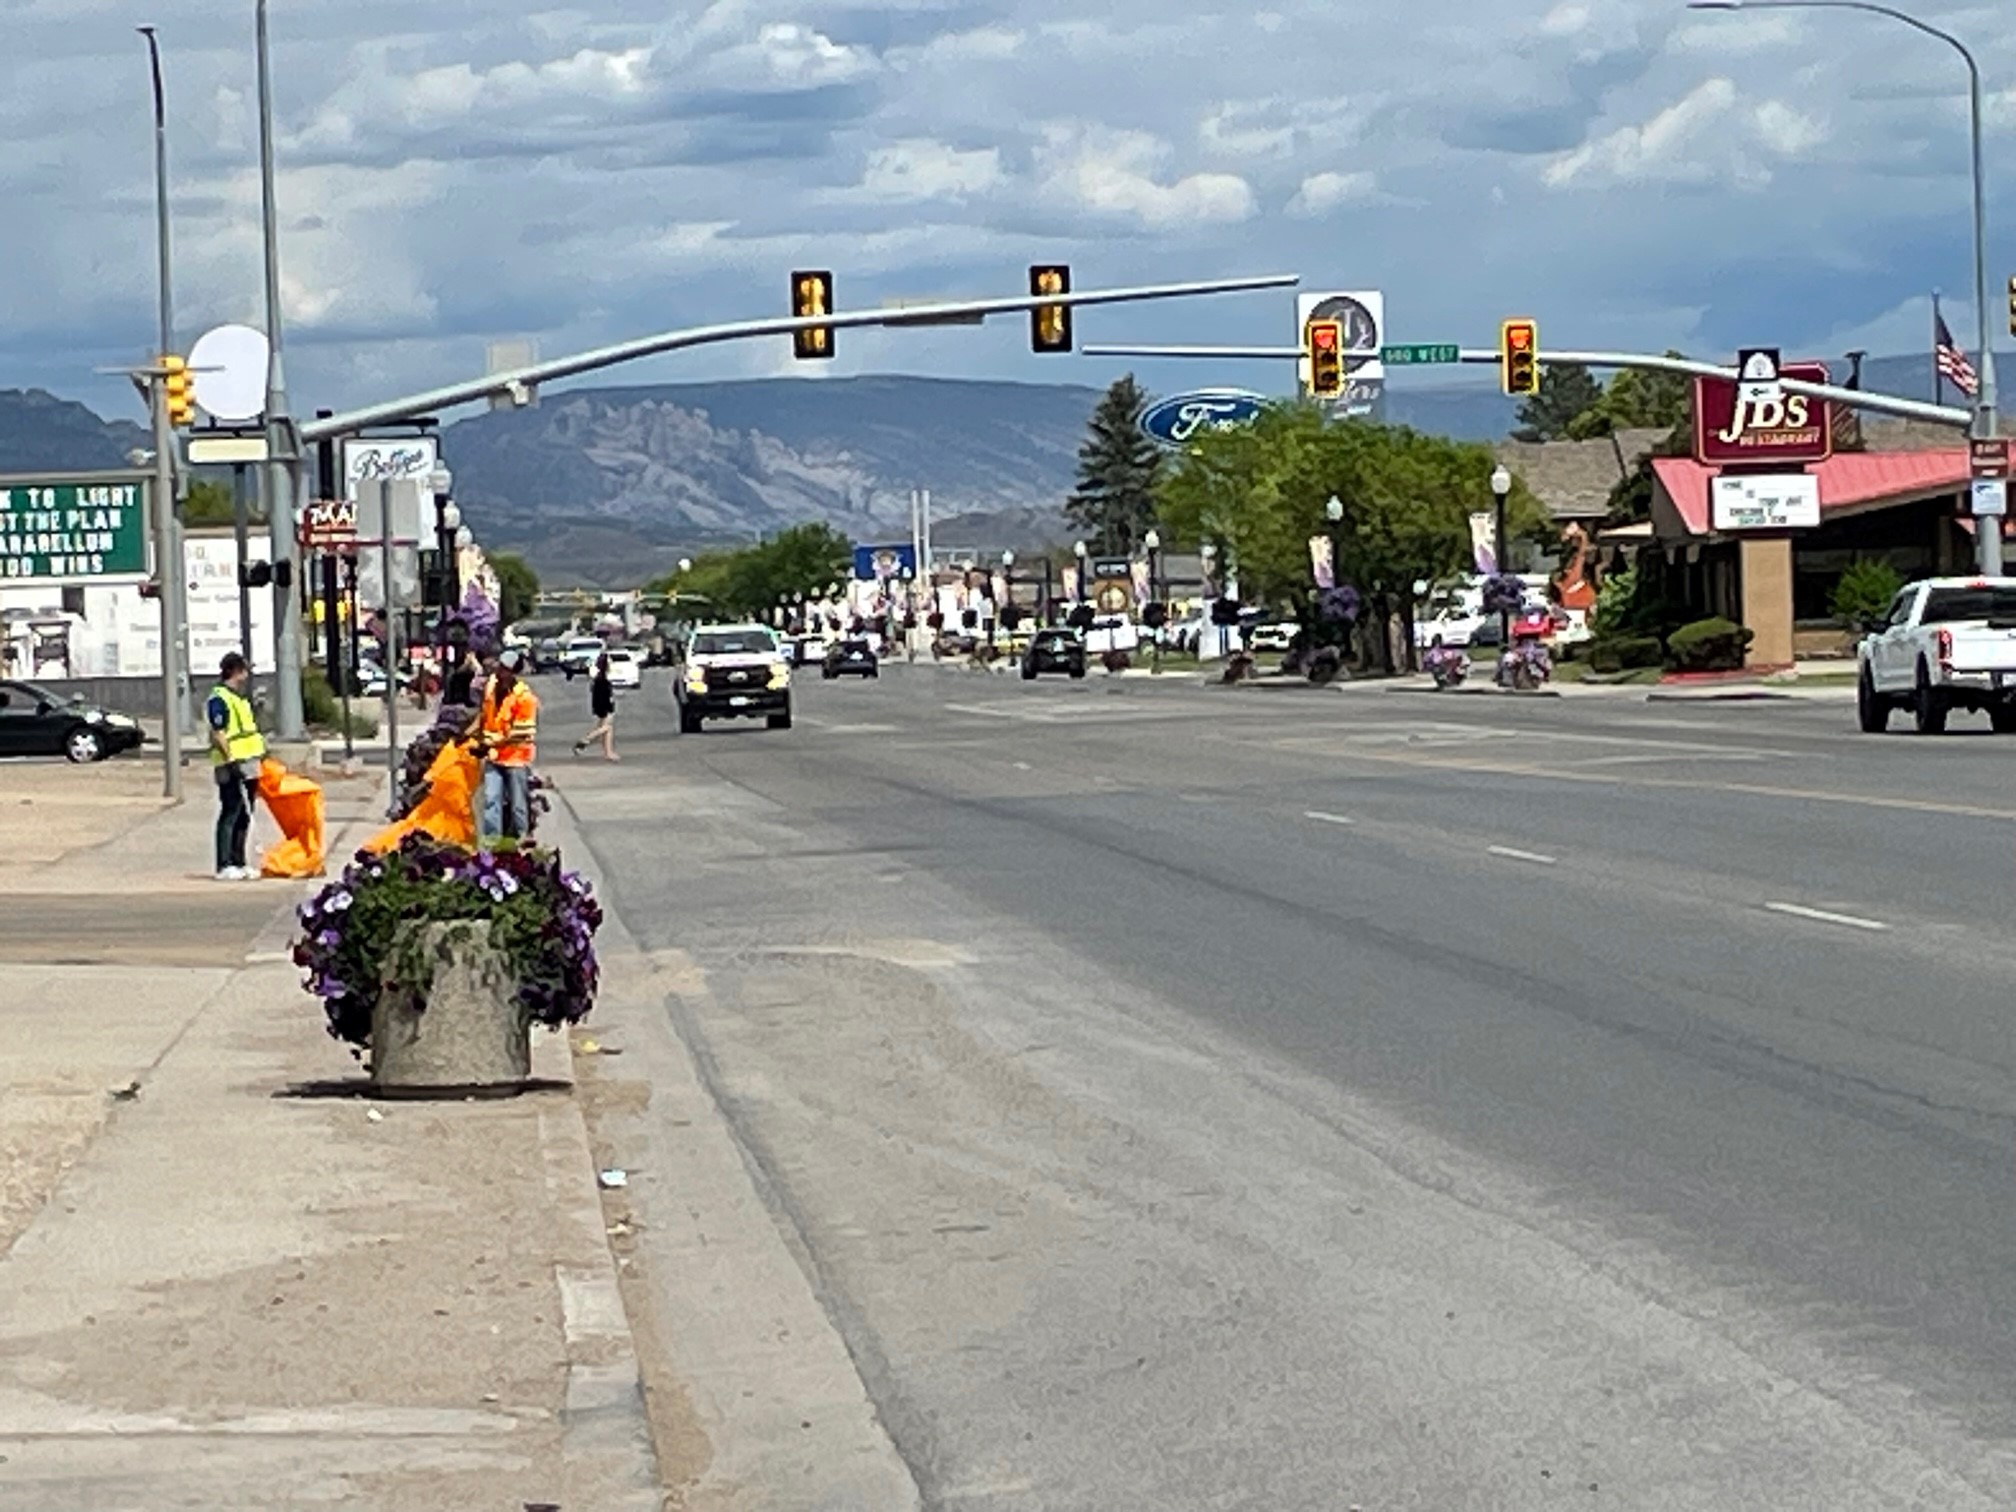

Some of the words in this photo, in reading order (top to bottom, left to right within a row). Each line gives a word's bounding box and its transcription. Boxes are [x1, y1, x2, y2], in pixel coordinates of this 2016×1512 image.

[27, 488, 54, 508] TO
[77, 486, 135, 506] LIGHT
[25, 511, 60, 531] THE
[67, 510, 121, 529] PLAN
[51, 555, 103, 575] WINS
